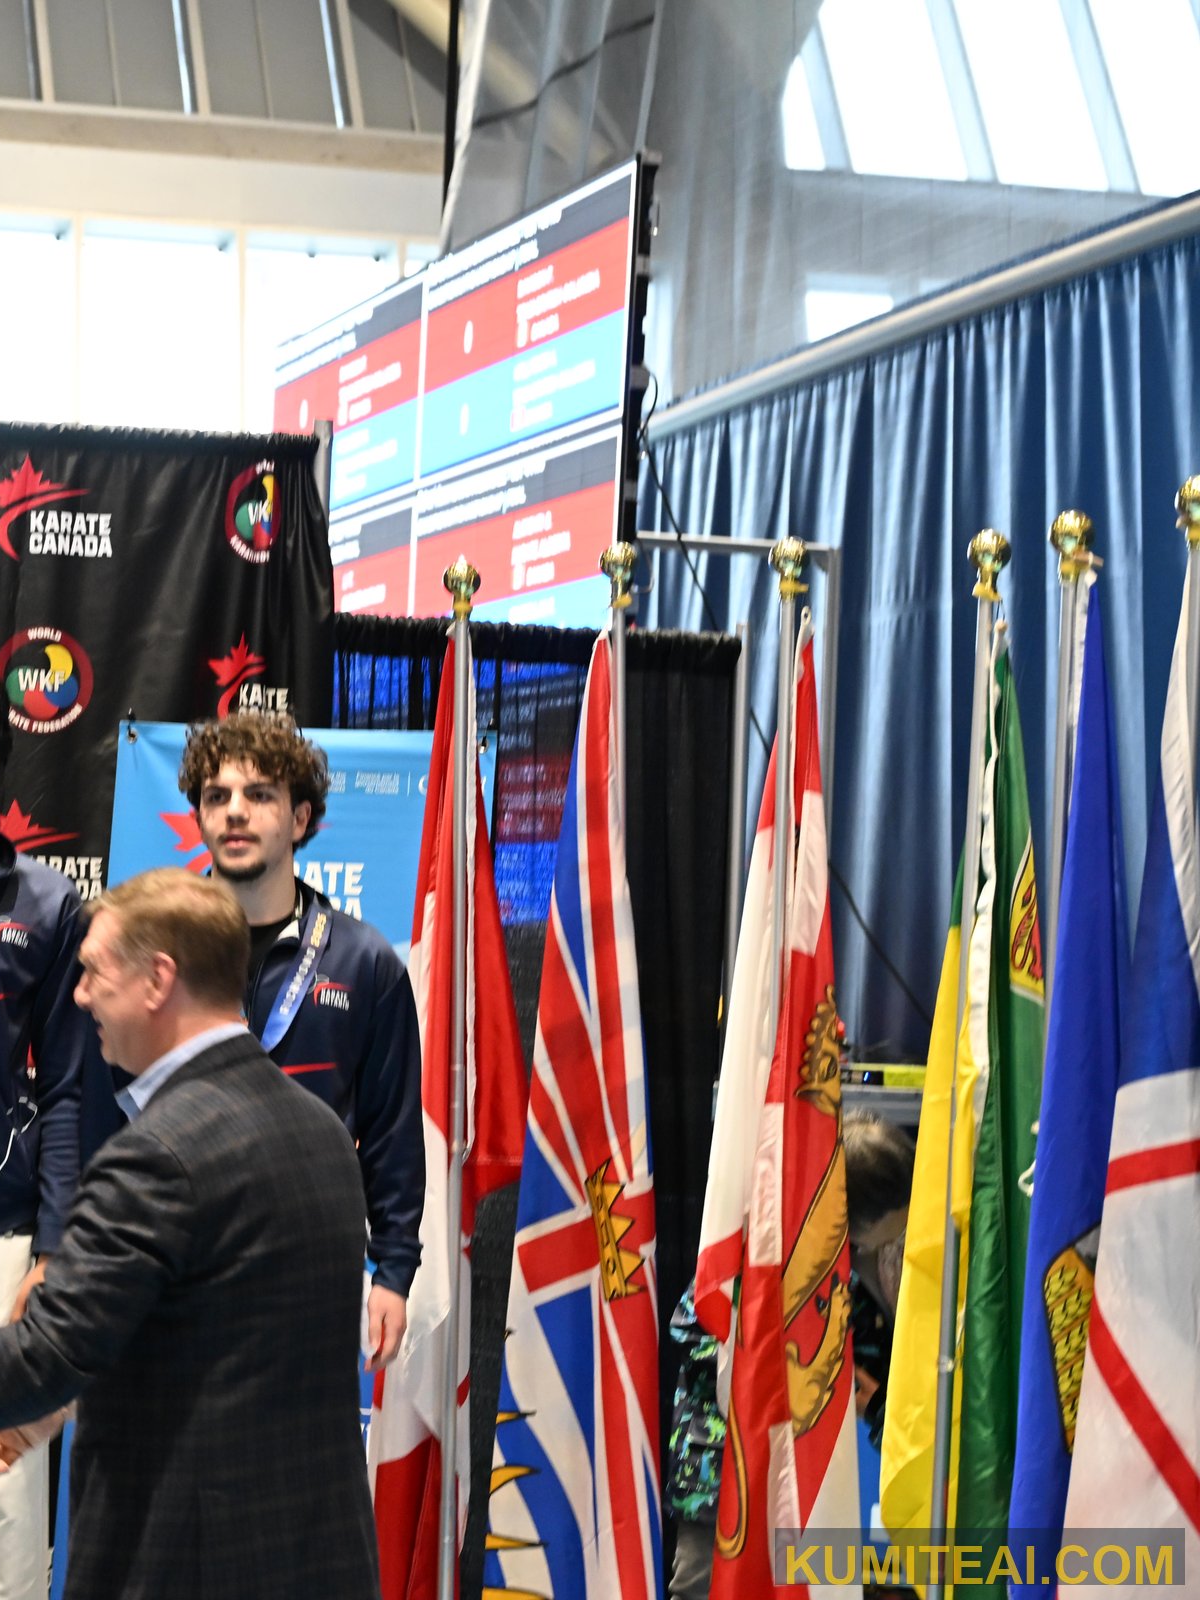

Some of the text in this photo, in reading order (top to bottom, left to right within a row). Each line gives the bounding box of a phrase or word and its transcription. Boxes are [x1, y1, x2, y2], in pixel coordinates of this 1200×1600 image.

[30, 510, 112, 536] KARATE
[29, 533, 112, 558] CANADA
[27, 626, 62, 642] WORLD
[18, 668, 65, 693] WKF
[36, 855, 103, 880] RATE
[294, 862, 364, 896] ATE
